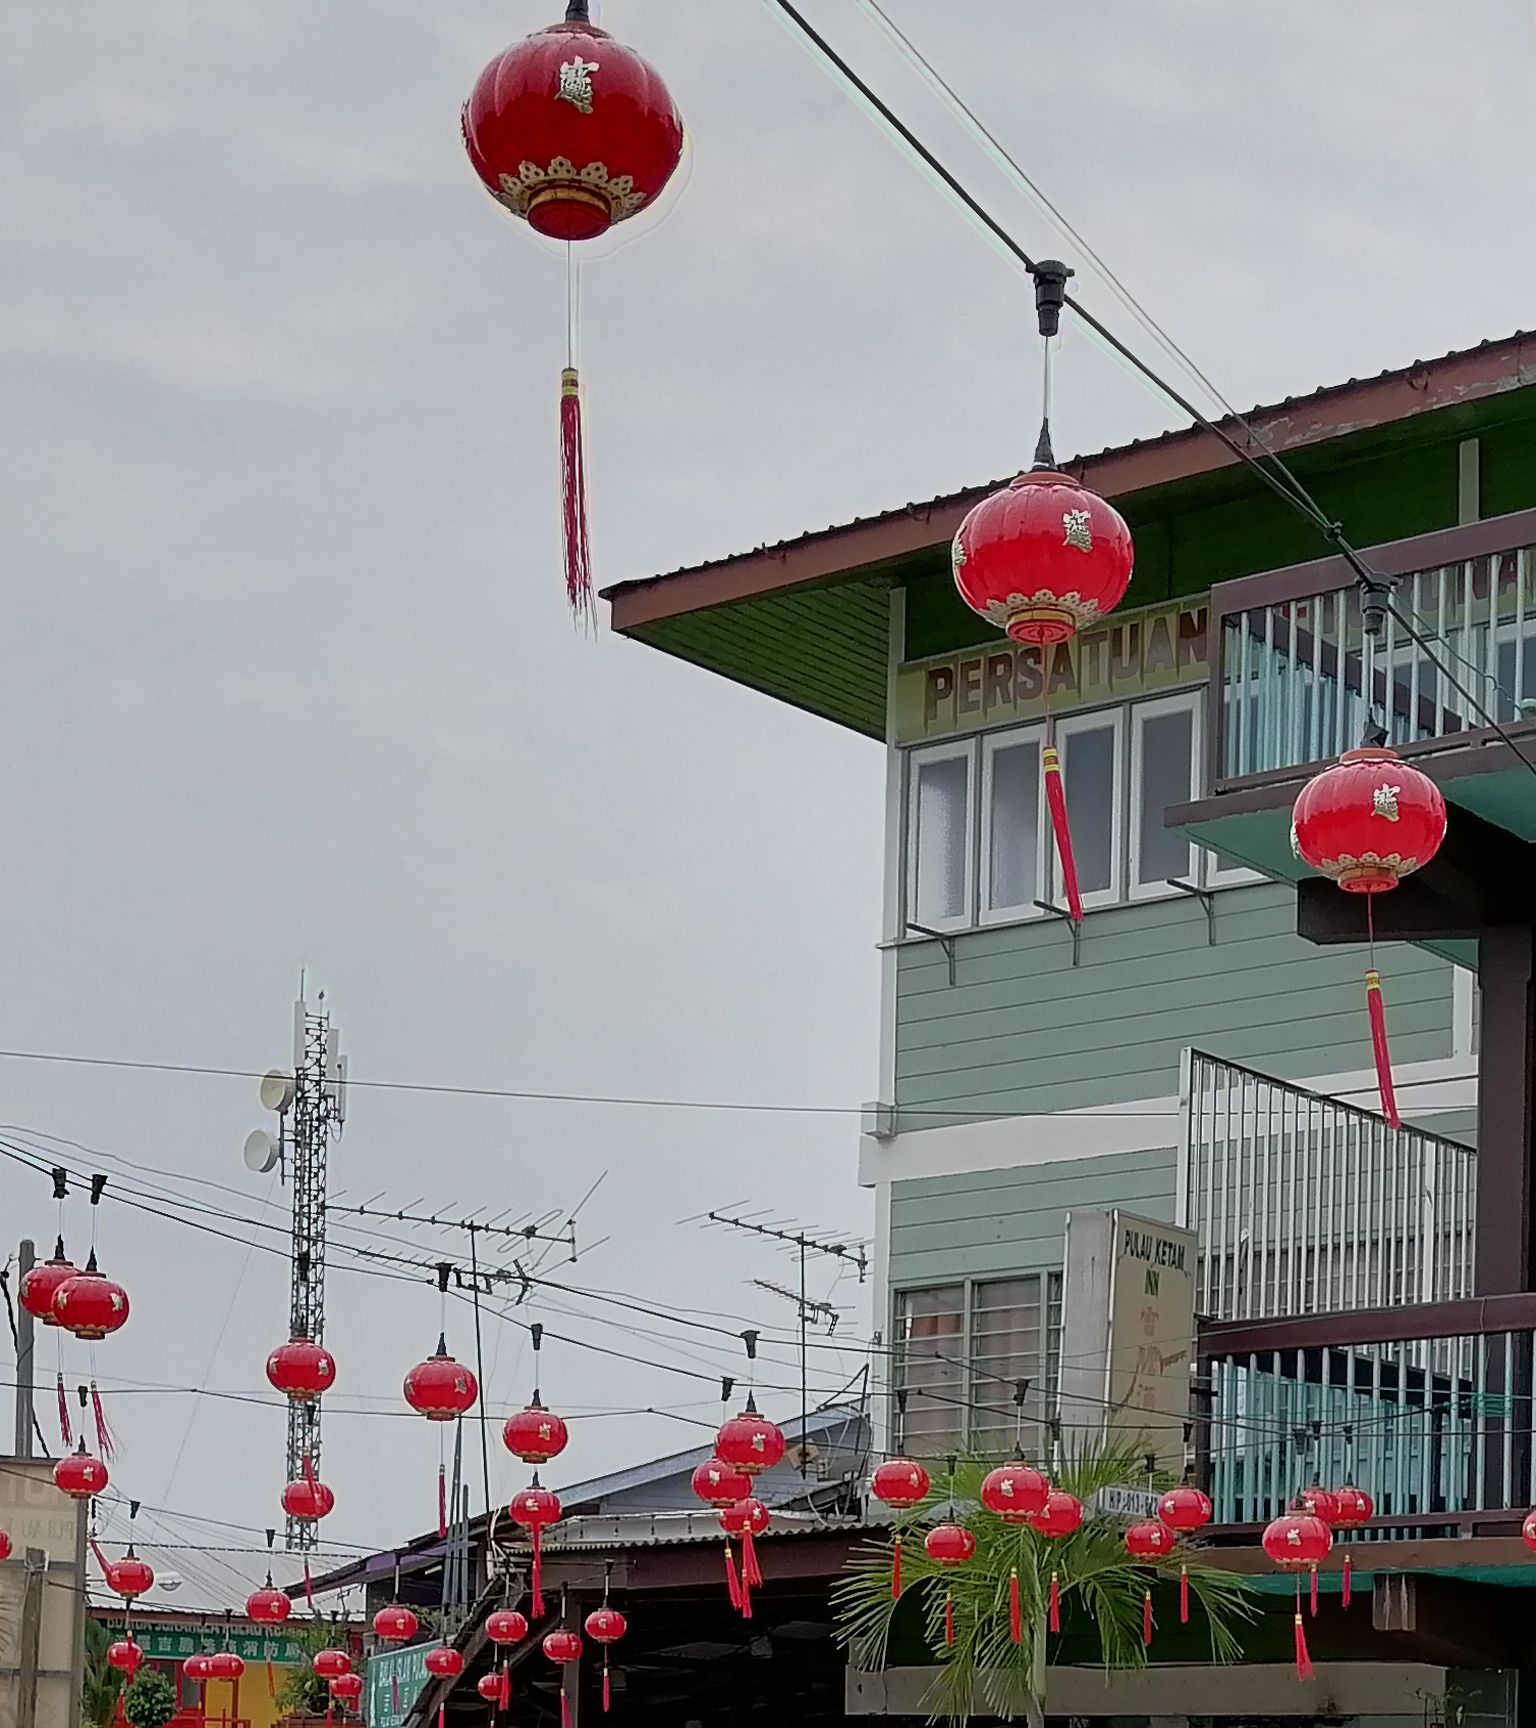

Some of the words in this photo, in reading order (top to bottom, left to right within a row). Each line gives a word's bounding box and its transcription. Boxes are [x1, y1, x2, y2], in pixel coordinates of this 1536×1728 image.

[925, 607, 1209, 722] PERSATUAN
[1125, 1230, 1152, 1261] PULAU
[1155, 1238, 1186, 1270] KETAM
[1144, 1269, 1160, 1298] INN
